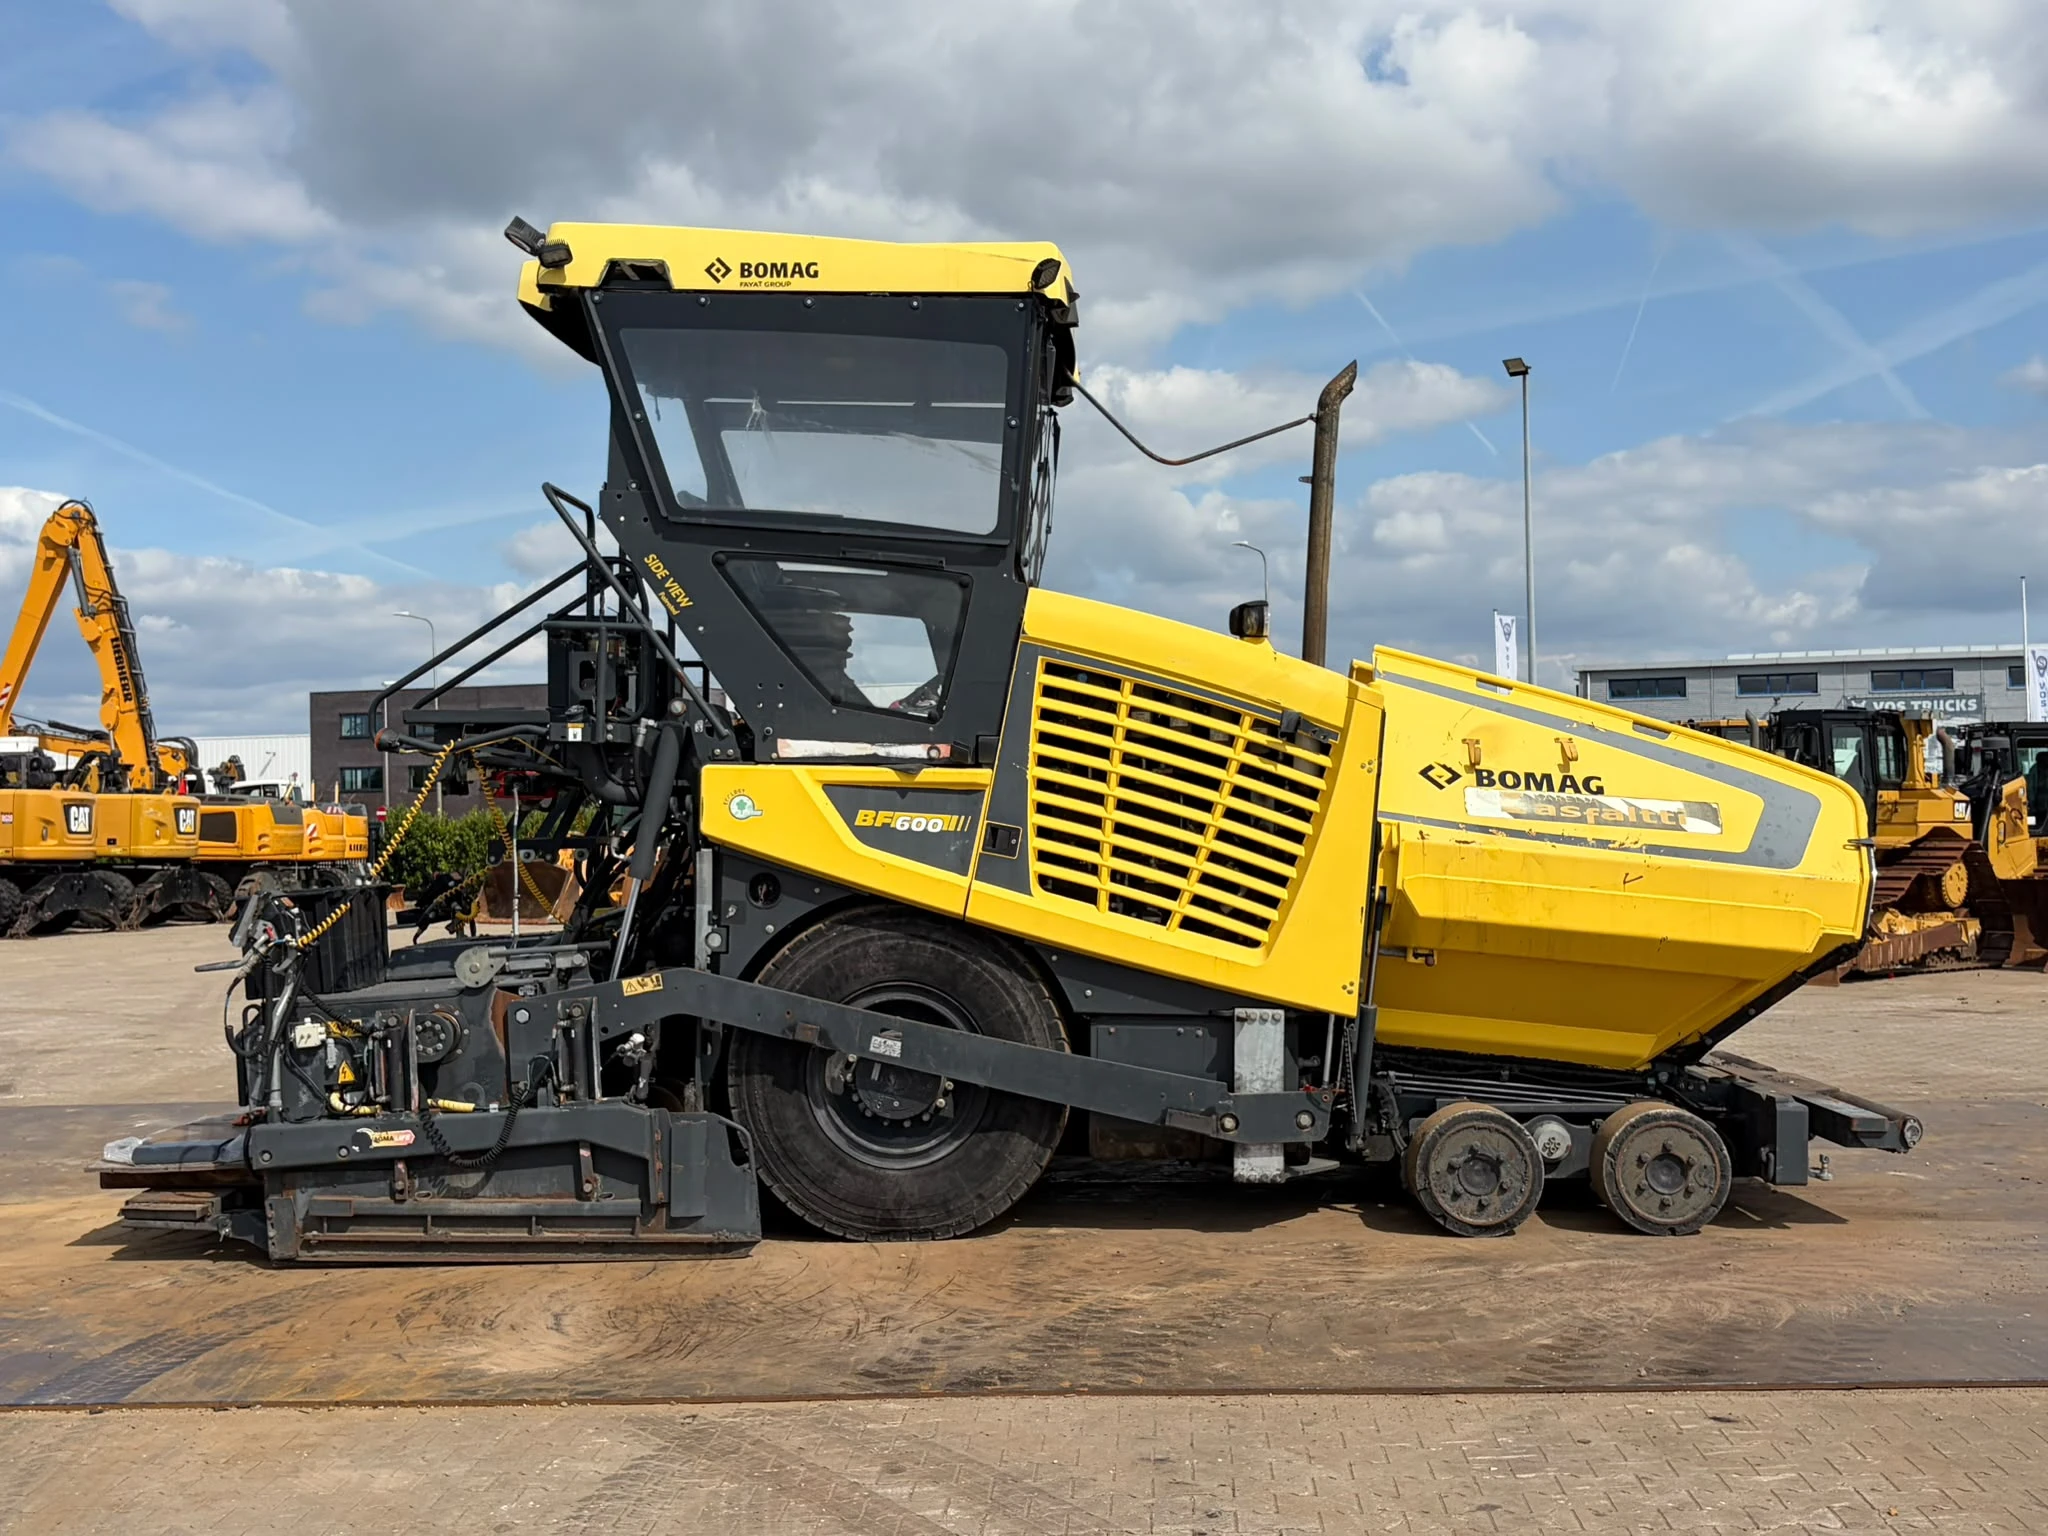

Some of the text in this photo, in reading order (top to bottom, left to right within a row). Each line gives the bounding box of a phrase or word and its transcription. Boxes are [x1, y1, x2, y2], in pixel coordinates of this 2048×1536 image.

[740, 262, 819, 278] BOMAG
[644, 553, 694, 607] SIDE VIEW
[111, 636, 132, 703] LIEBHERR
[1872, 699, 1978, 712] VOS TRUCKS
[1475, 768, 1605, 795] BOMAG
[70, 806, 90, 832] CAT
[179, 808, 195, 833] CAT
